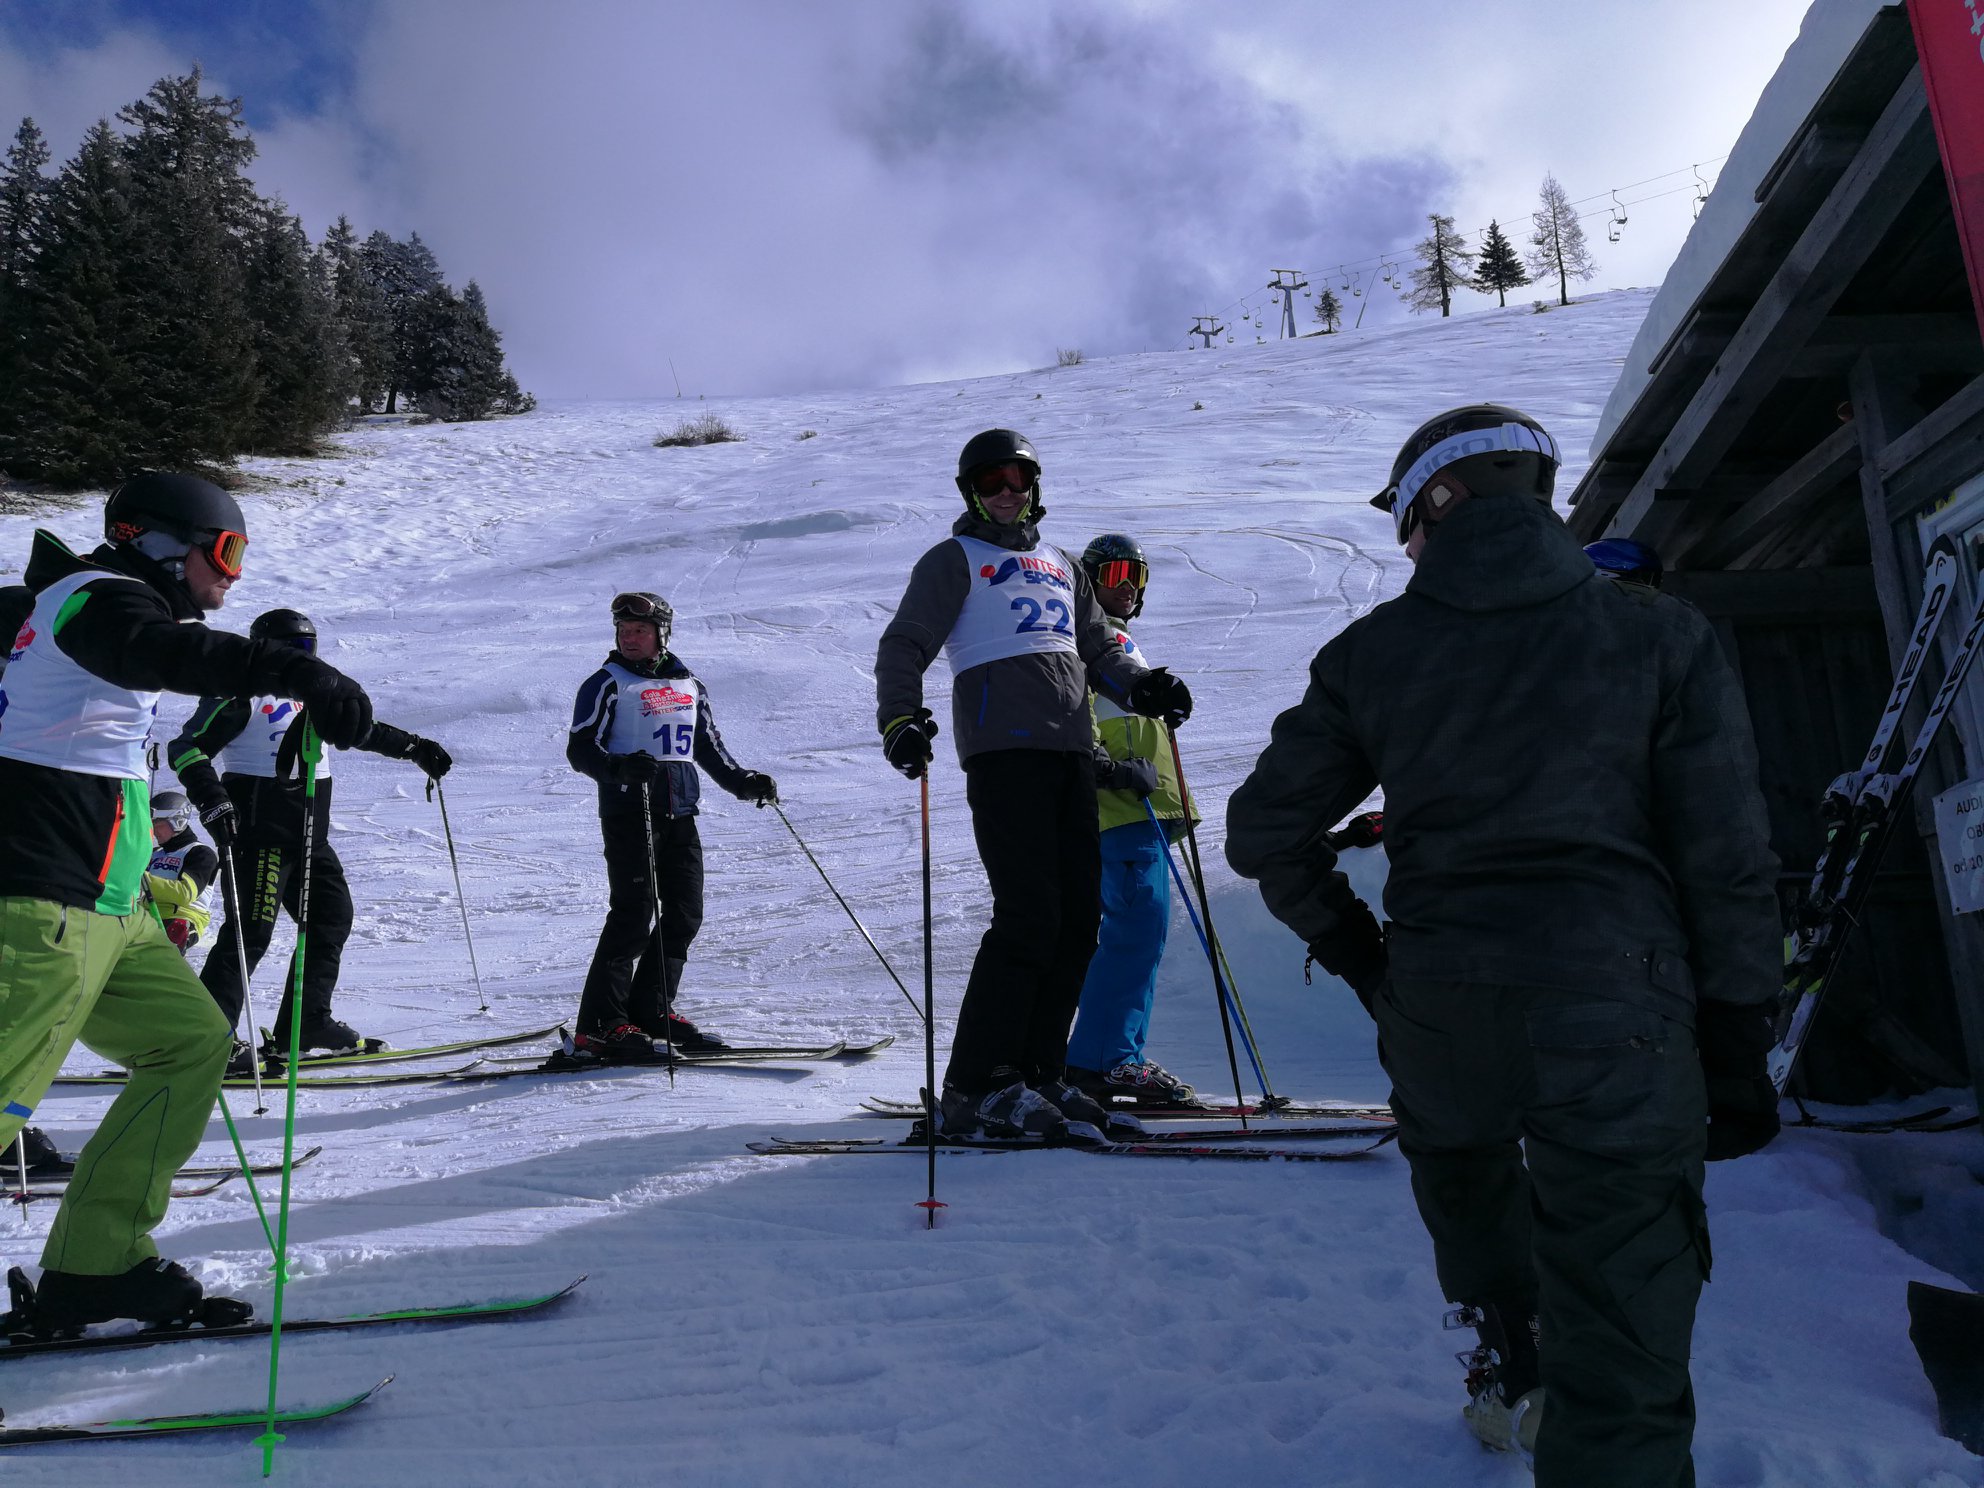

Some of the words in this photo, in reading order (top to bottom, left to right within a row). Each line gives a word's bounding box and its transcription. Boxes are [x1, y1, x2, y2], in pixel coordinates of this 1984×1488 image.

[1011, 597, 1074, 637] 22
[1887, 583, 1946, 714] HEAD
[653, 724, 693, 755] 15
[974, 1111, 1006, 1125] HEAD
